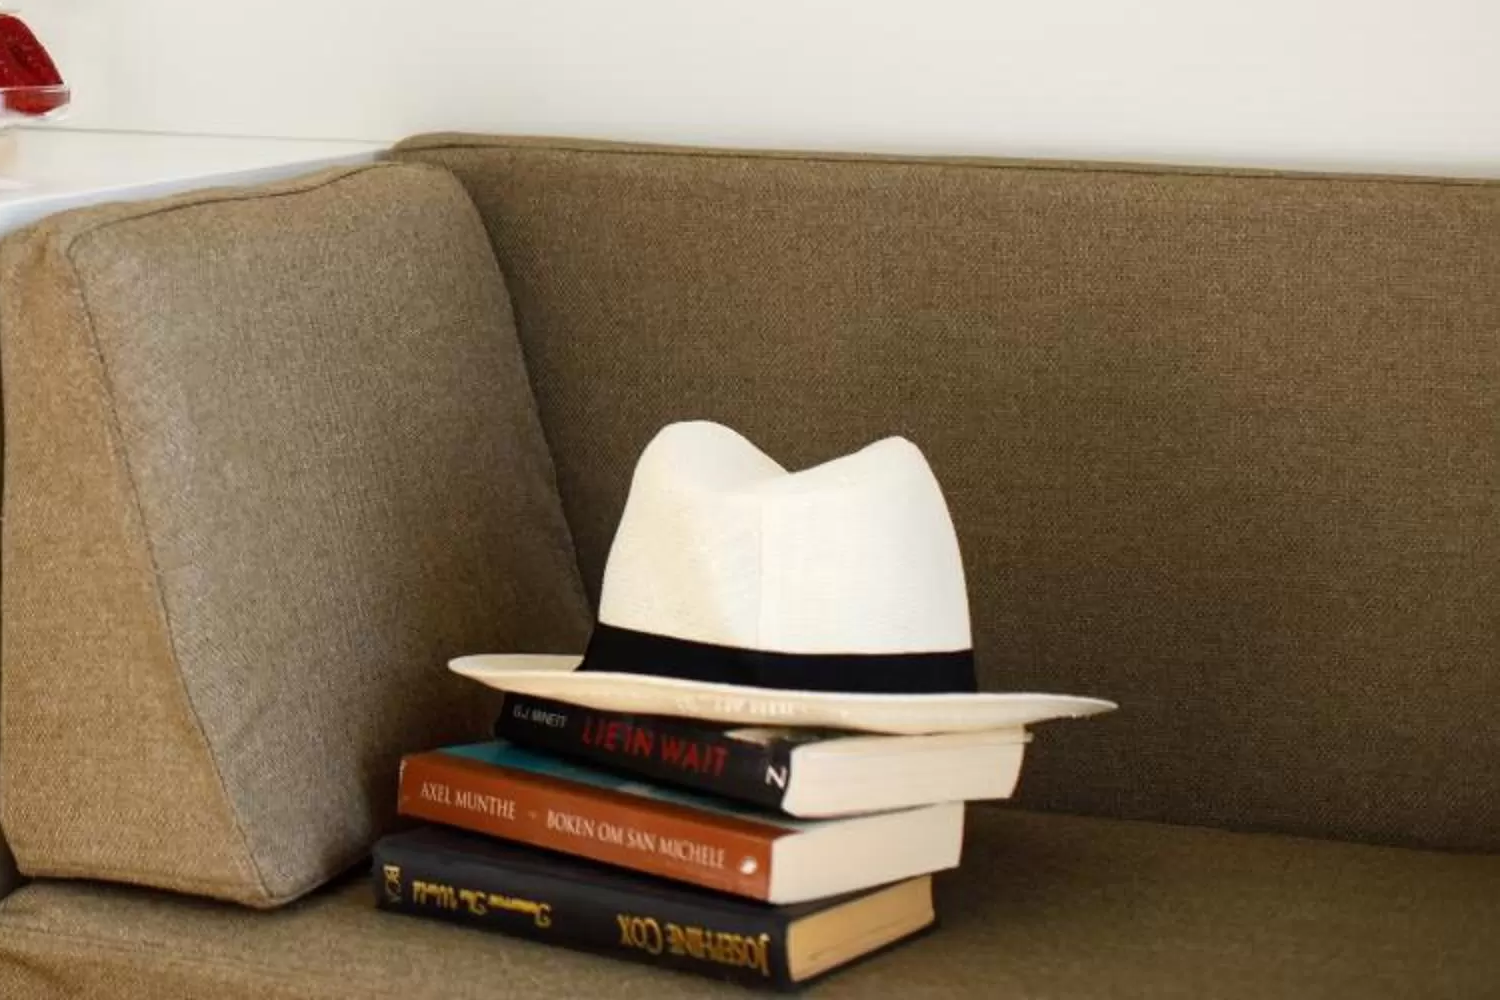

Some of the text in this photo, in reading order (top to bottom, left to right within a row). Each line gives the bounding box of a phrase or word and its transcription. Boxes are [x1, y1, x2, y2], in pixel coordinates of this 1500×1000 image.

[624, 724, 655, 757] IN
[659, 733, 729, 776] WAIT
[420, 780, 516, 820] AXEL MUNTHE
[546, 809, 726, 869] BOKEN OM SAN MICHELE
